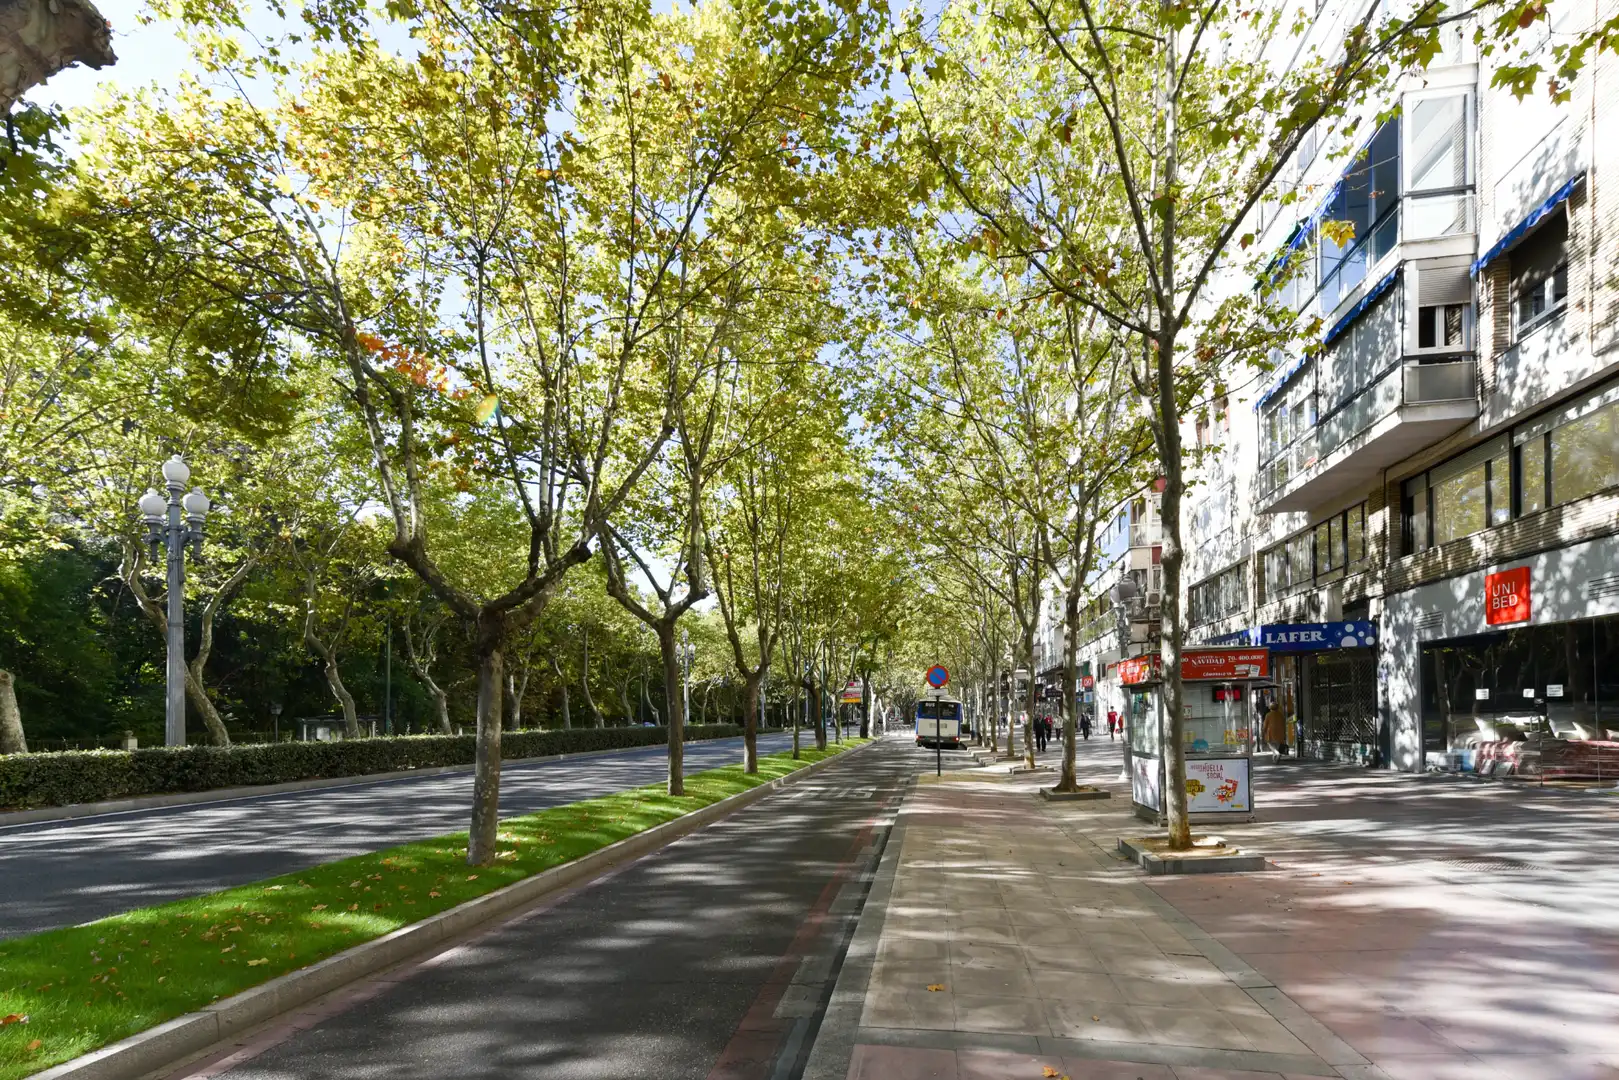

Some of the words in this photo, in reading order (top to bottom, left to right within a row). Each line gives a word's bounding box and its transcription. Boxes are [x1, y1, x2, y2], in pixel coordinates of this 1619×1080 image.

[1492, 581, 1515, 597] UNI
[1492, 594, 1518, 609] BED
[1266, 630, 1327, 644] LAFER
[1191, 657, 1225, 667] NAVIDAD
